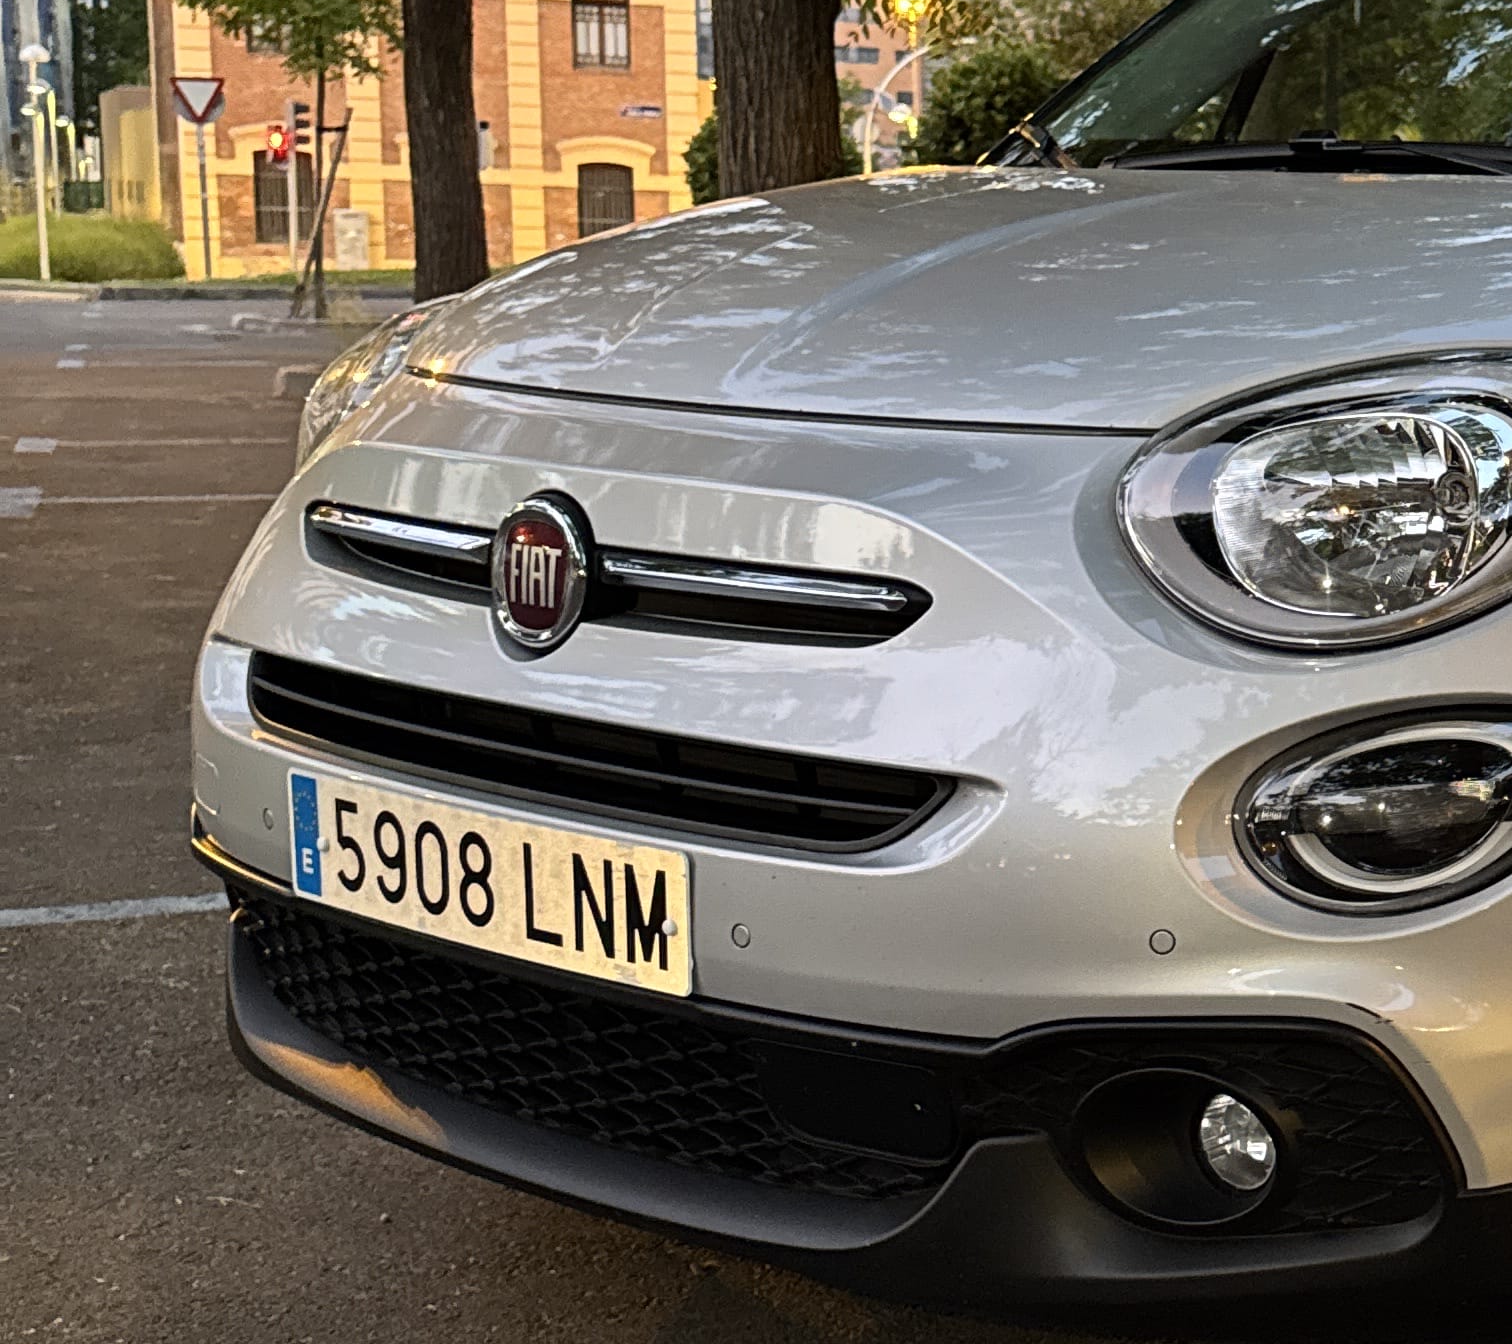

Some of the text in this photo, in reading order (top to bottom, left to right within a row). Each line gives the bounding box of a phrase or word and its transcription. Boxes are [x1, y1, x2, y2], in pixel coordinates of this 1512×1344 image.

[510, 543, 562, 608] FIAT
[301, 847, 314, 874] E
[335, 798, 668, 970] 5908 LNM
